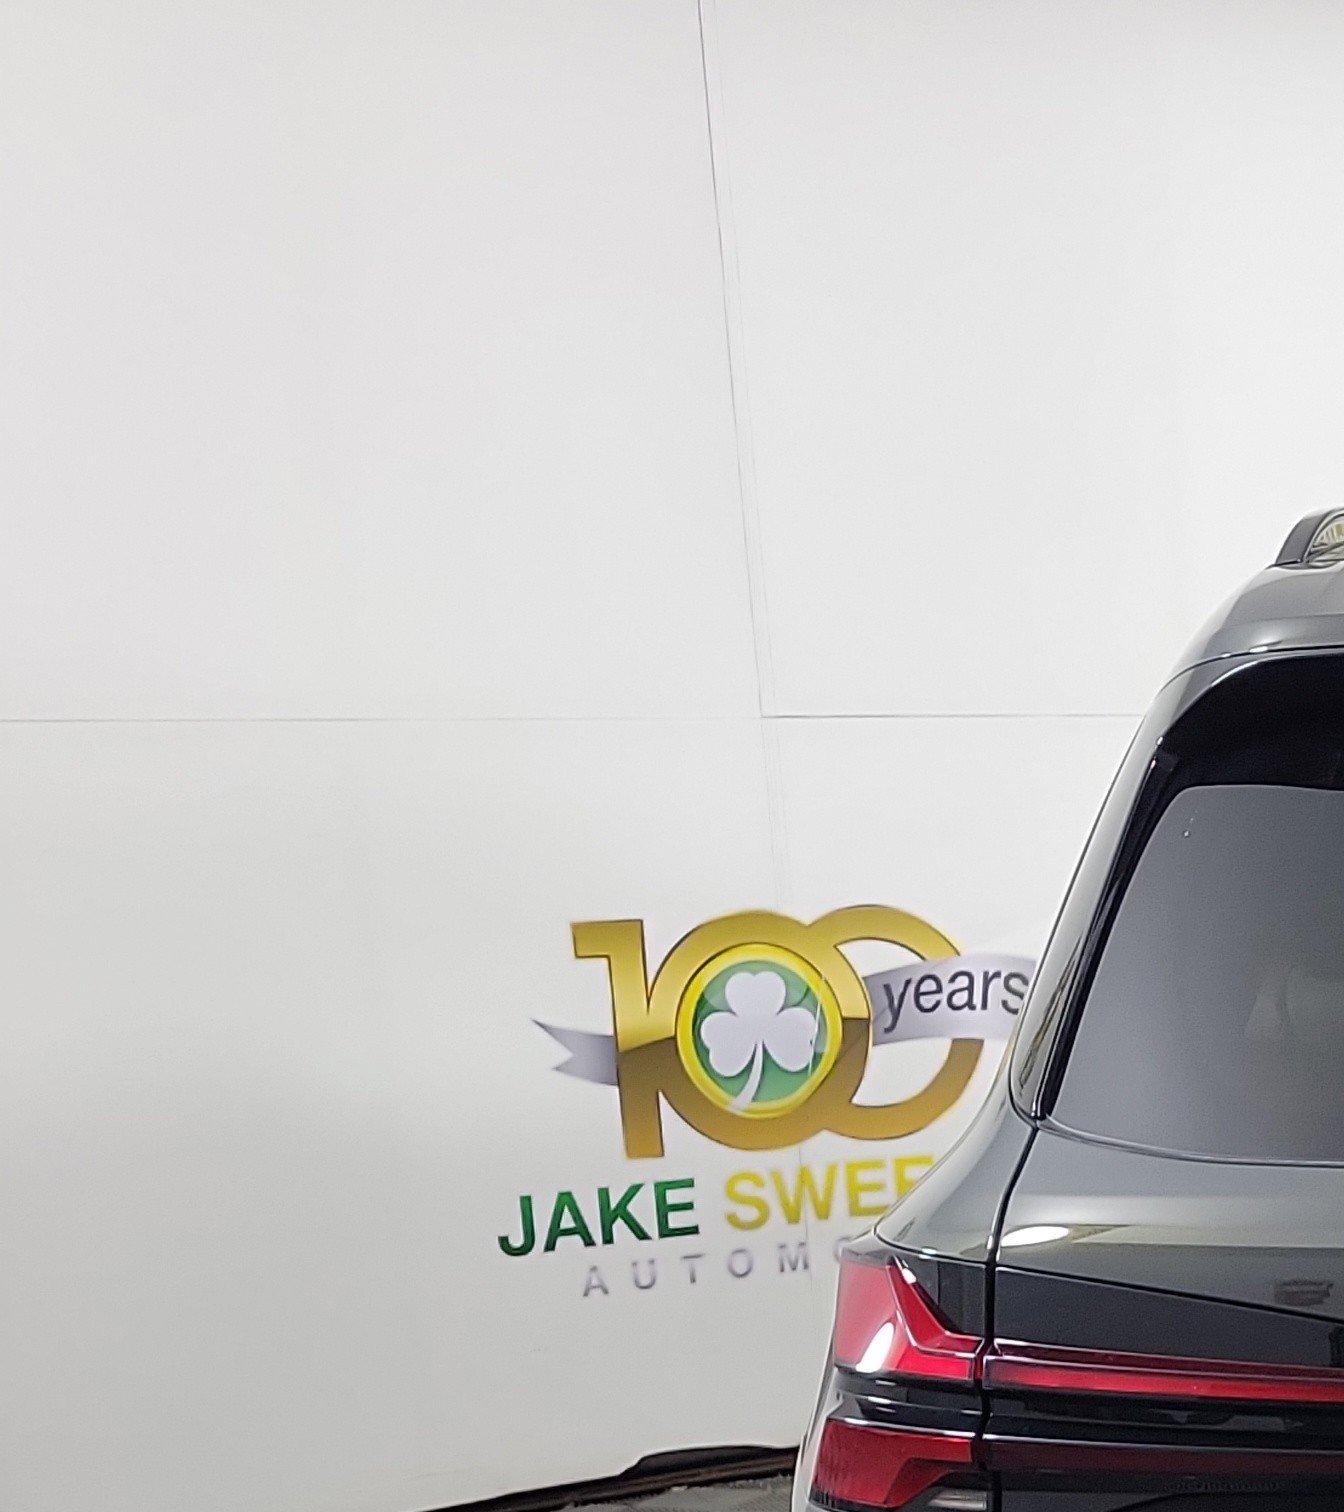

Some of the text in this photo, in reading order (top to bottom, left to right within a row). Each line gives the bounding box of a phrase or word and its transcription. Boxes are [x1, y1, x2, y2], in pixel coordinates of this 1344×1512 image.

[571, 905, 1029, 1159] 100 years
[497, 1178, 700, 1257] JAKE
